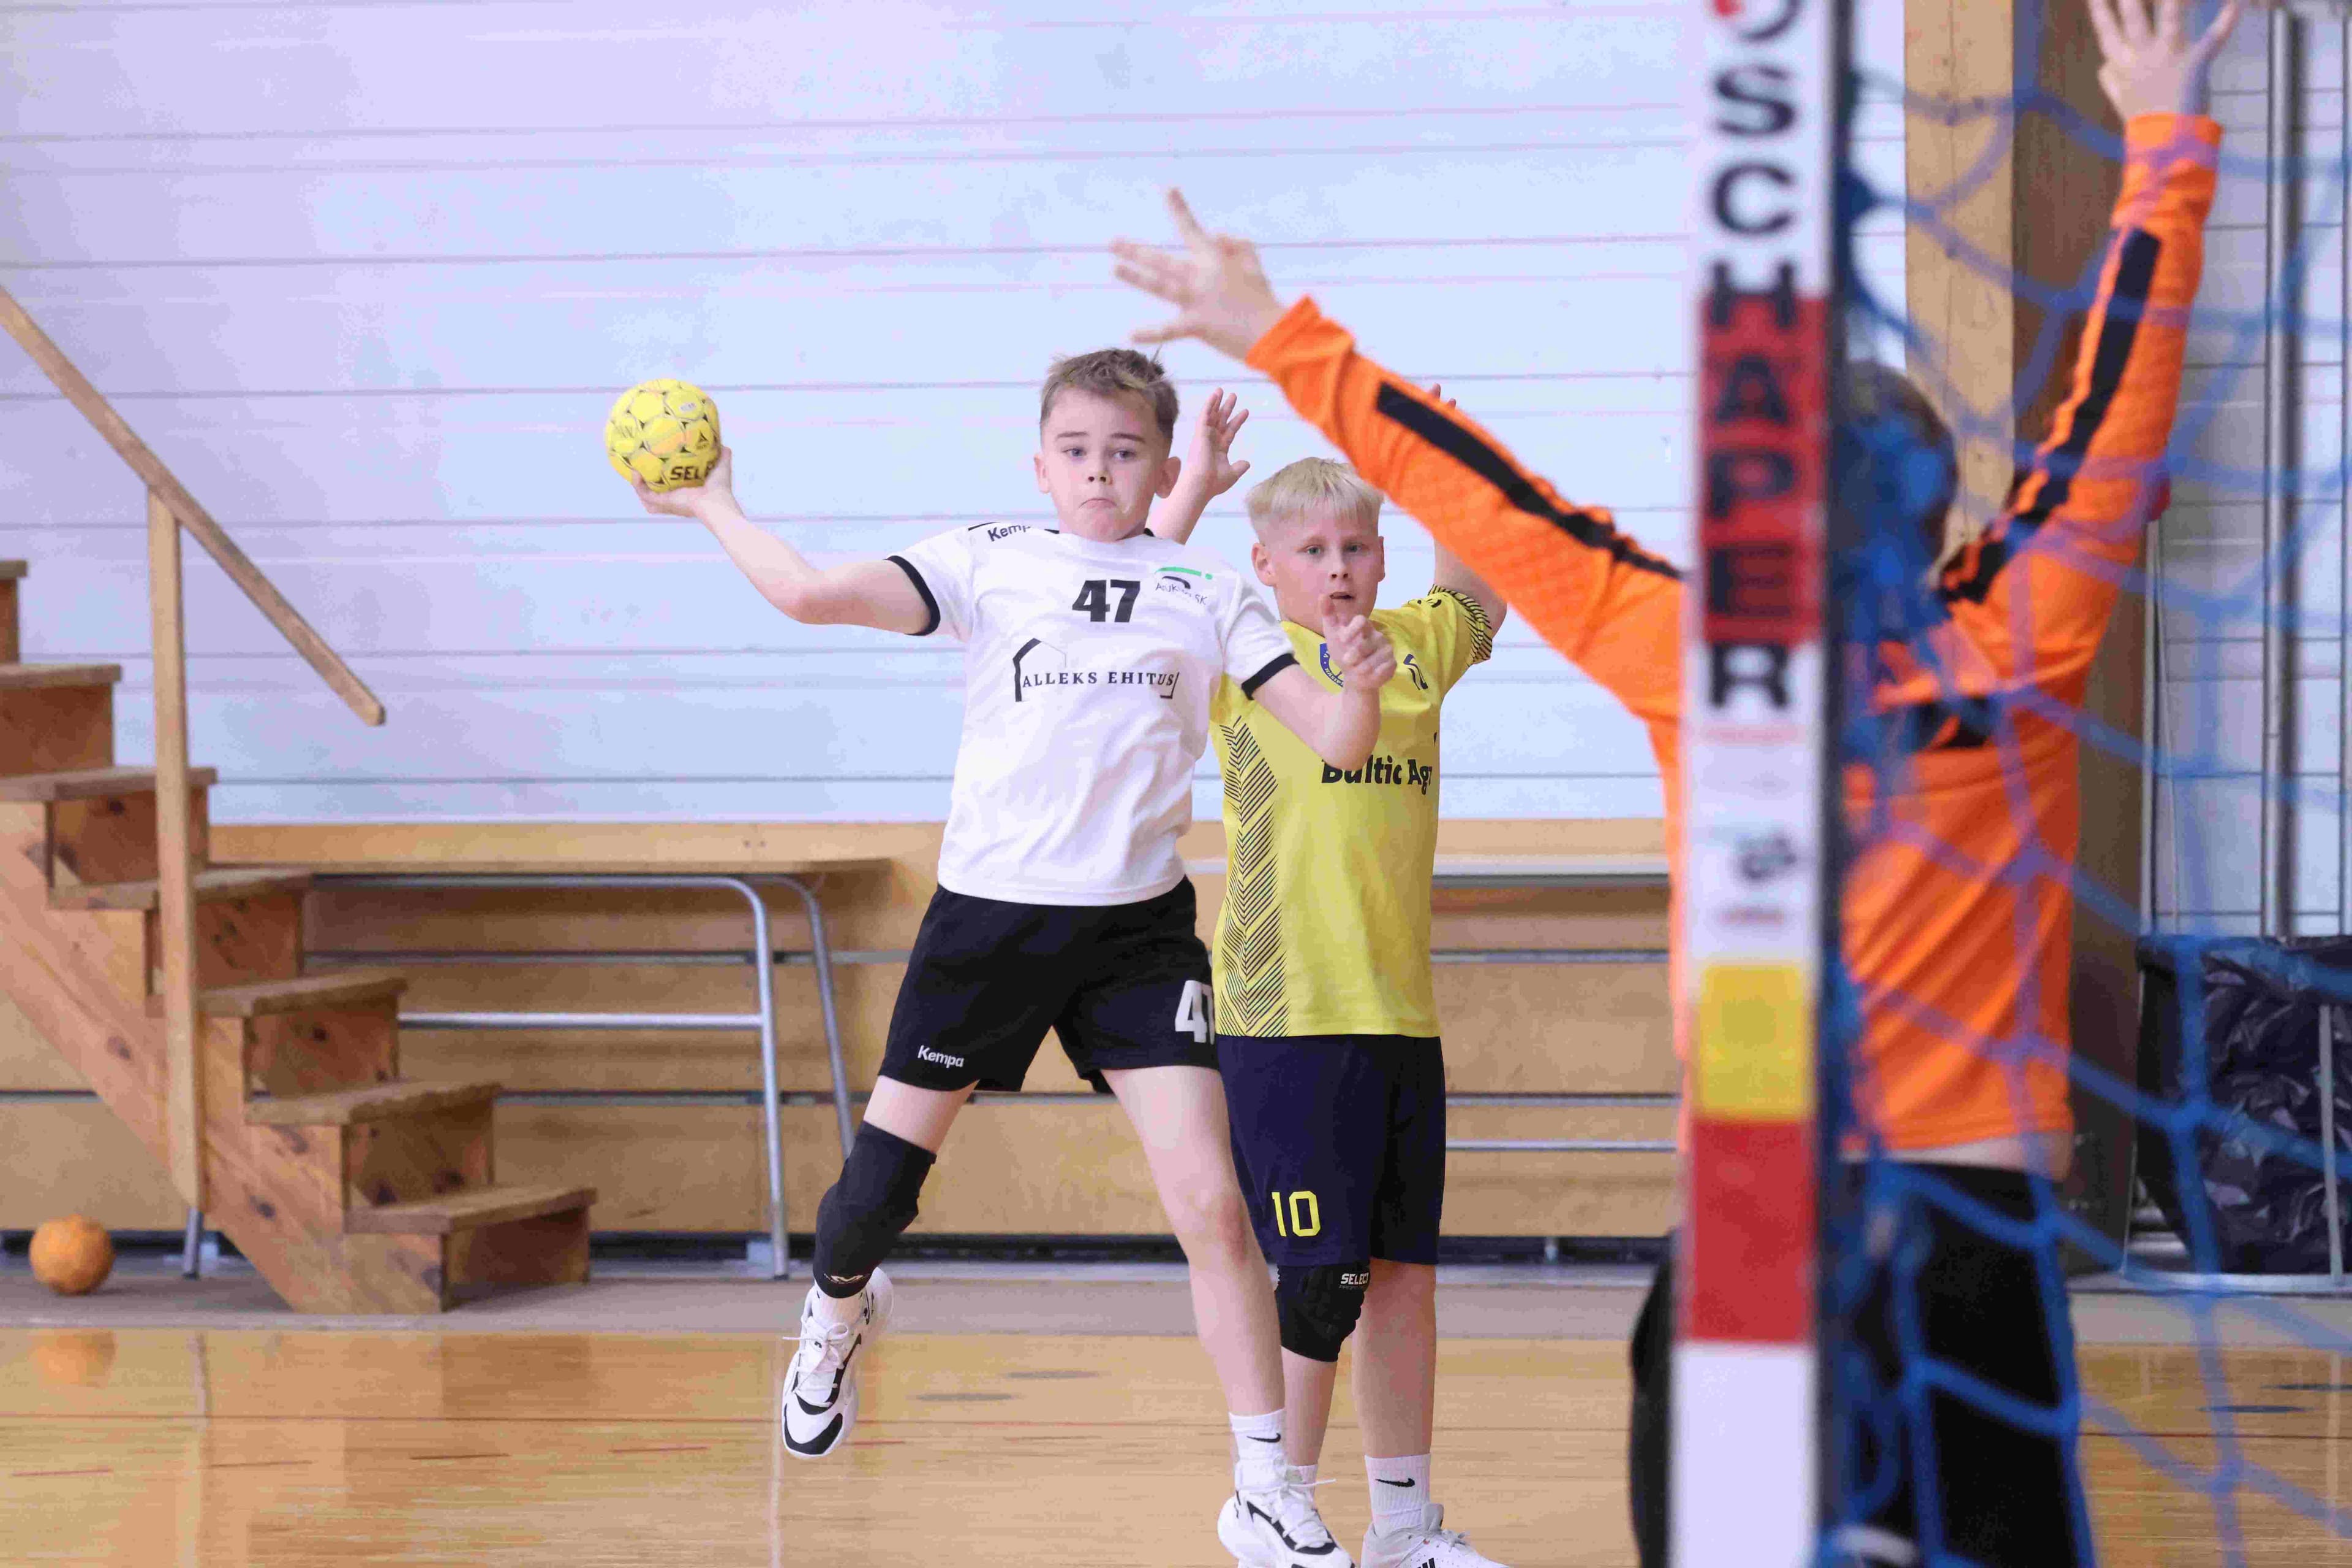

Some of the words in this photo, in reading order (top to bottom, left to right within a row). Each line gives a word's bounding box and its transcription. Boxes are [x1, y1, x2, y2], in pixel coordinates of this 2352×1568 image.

[1072, 579, 1141, 623] 47
[1022, 671, 1098, 688] ALLEKS
[1107, 671, 1174, 686] EHITUS
[917, 1044, 965, 1069] Kempa
[1272, 1190, 1321, 1237] 10
[1340, 1272, 1370, 1285] SELECT
